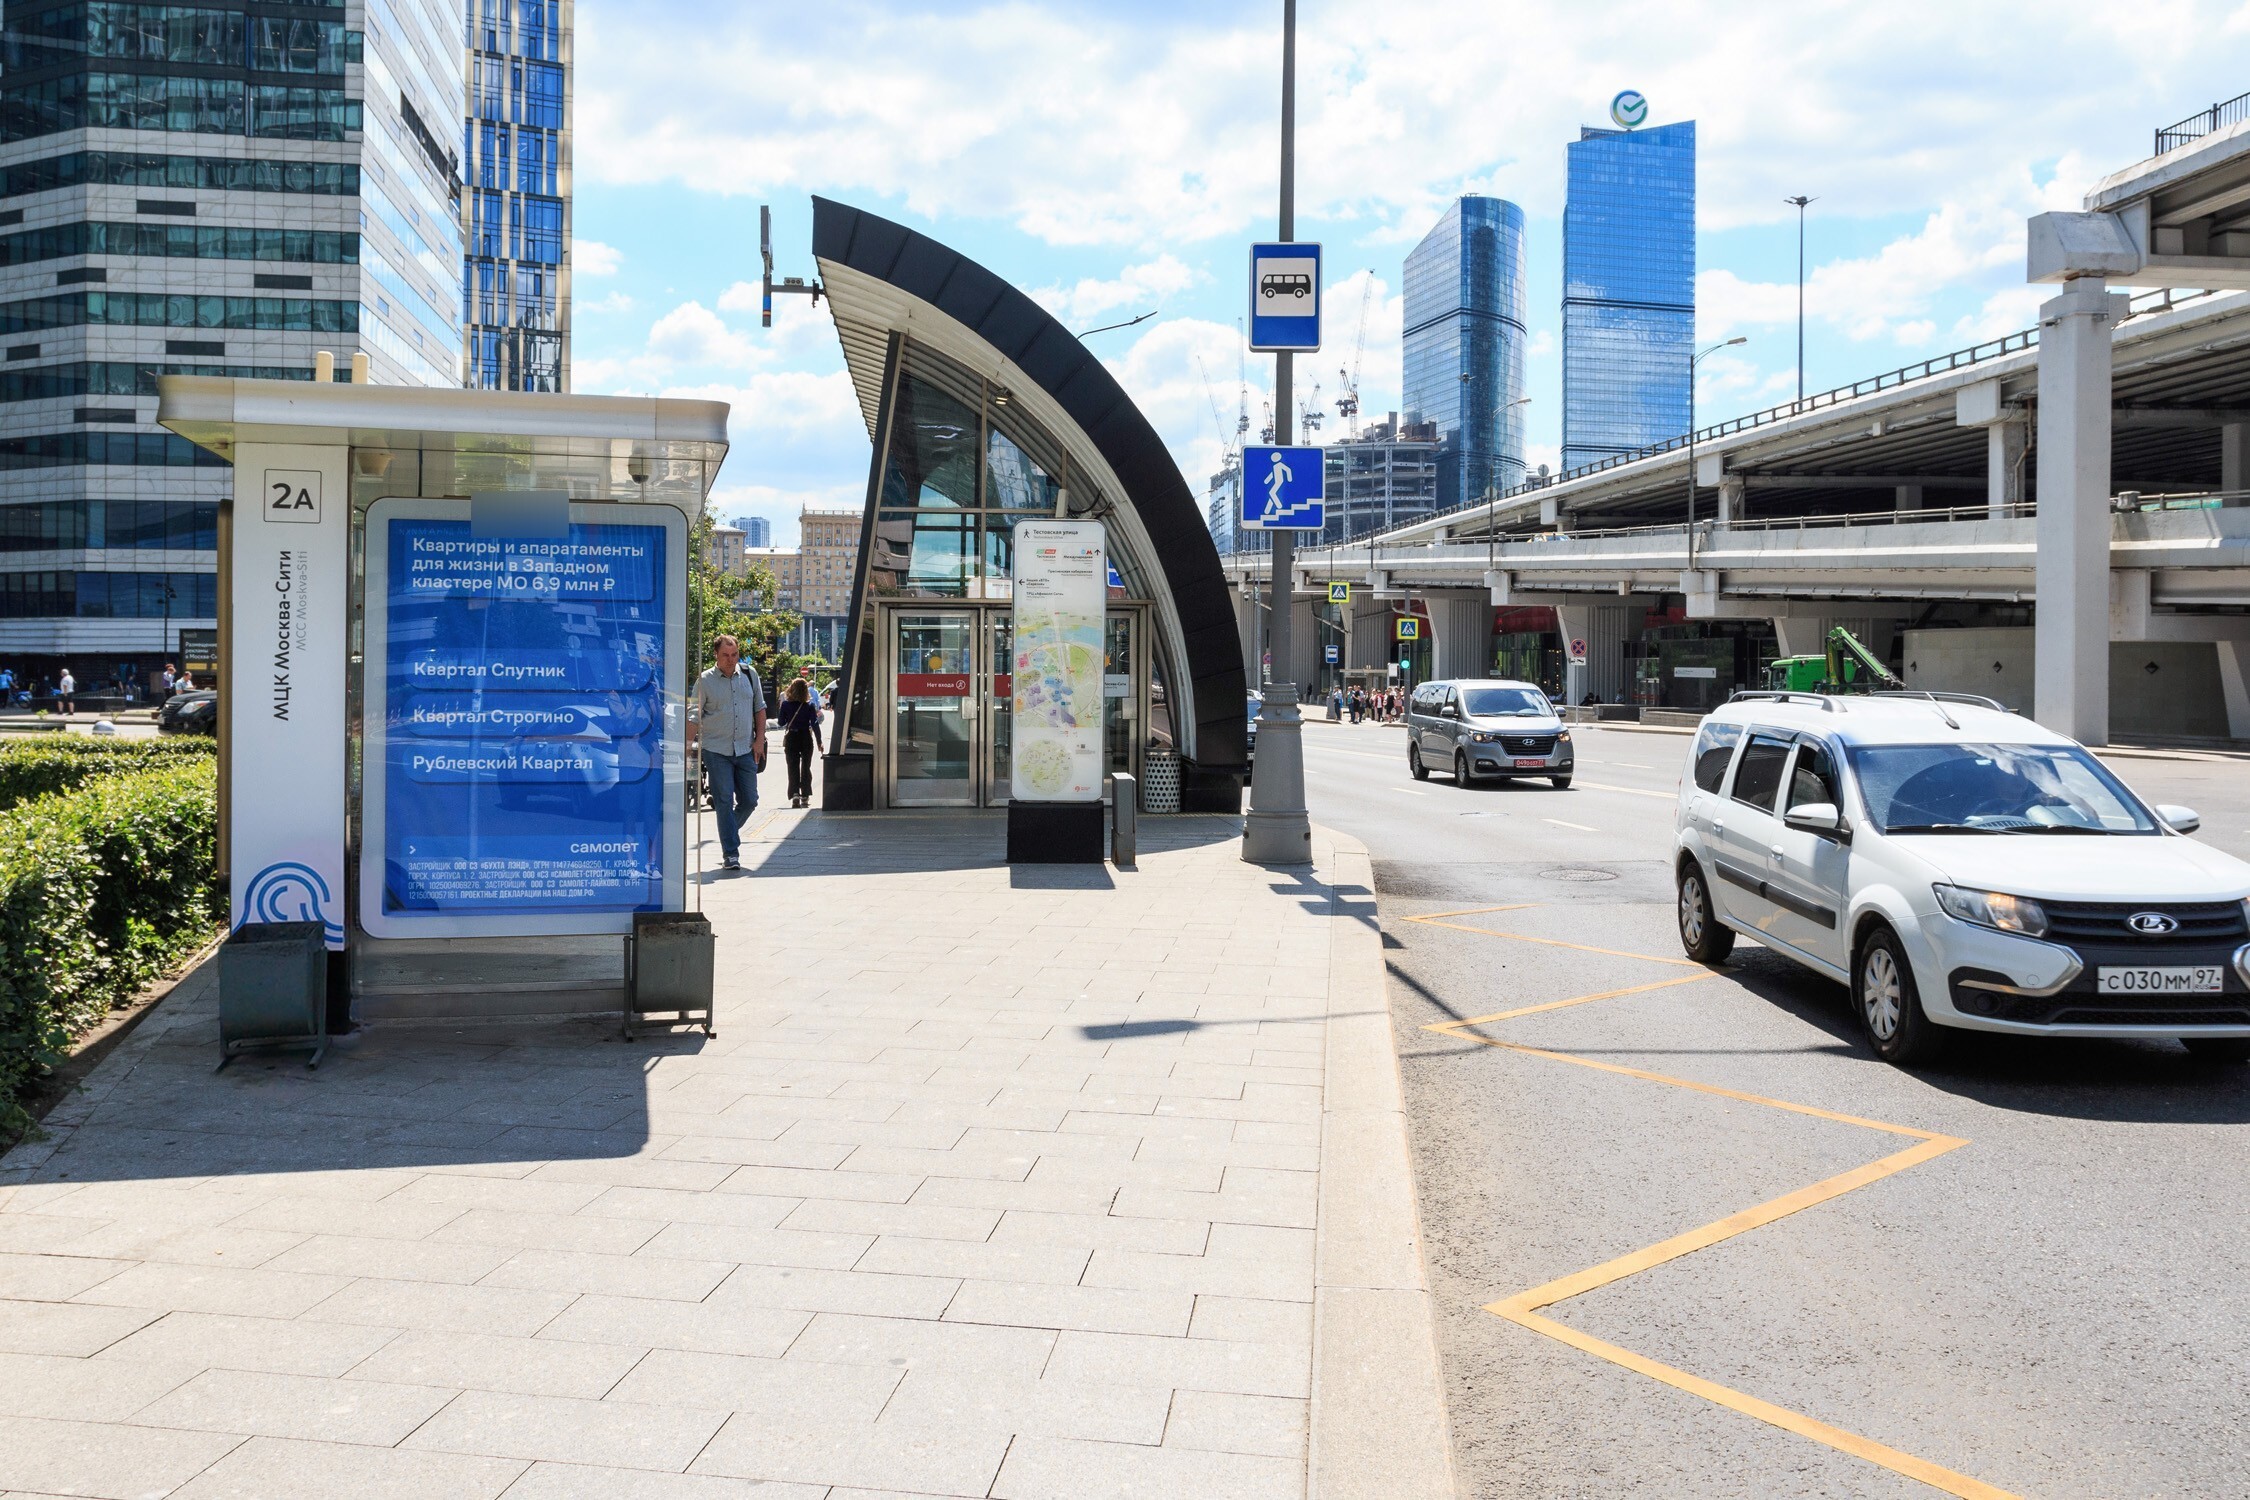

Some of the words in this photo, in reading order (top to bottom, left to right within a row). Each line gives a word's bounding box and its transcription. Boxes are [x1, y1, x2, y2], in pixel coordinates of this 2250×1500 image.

[271, 482, 315, 510] 2А
[413, 538, 500, 556] Квартиры
[505, 543, 515, 554] и
[520, 544, 644, 558] апаратаменты
[412, 558, 444, 572] для
[448, 560, 504, 572] жизни
[508, 562, 518, 572] в
[522, 558, 609, 574] Западном
[296, 551, 308, 620] Moskva-Siti
[412, 577, 492, 592] кластере
[498, 576, 528, 590] МО
[532, 577, 560, 592] 6,9
[565, 580, 599, 591] млн
[603, 579, 616, 591] ₽
[274, 550, 292, 670] Москва-Сити
[295, 622, 308, 652] MCC
[414, 662, 486, 680] Квартал
[491, 663, 566, 680] Спутник
[273, 674, 292, 722] МЦК
[414, 708, 486, 728] Квартал
[490, 709, 574, 726] Строгино
[413, 756, 518, 772] Рублевский
[522, 756, 592, 772] Квартал
[570, 842, 639, 853] самолет
[408, 861, 451, 870] ЗАСТРОЙЩИК
[454, 862, 467, 870] ООО
[480, 861, 505, 870] «БУХТА
[534, 861, 550, 869] ОГРН
[432, 872, 460, 880] КОРПУСА
[479, 870, 520, 880] ЗАСТРОЙЩИК
[408, 882, 424, 890] ОГРН
[485, 880, 526, 889] ЗАСТРОЙЩИК
[531, 880, 543, 888] ООО
[460, 890, 498, 898] ПРОЕКТНЫЕ
[499, 890, 541, 898] ДЕКЛАРАЦИИ
[2196, 970, 2215, 984] 97
